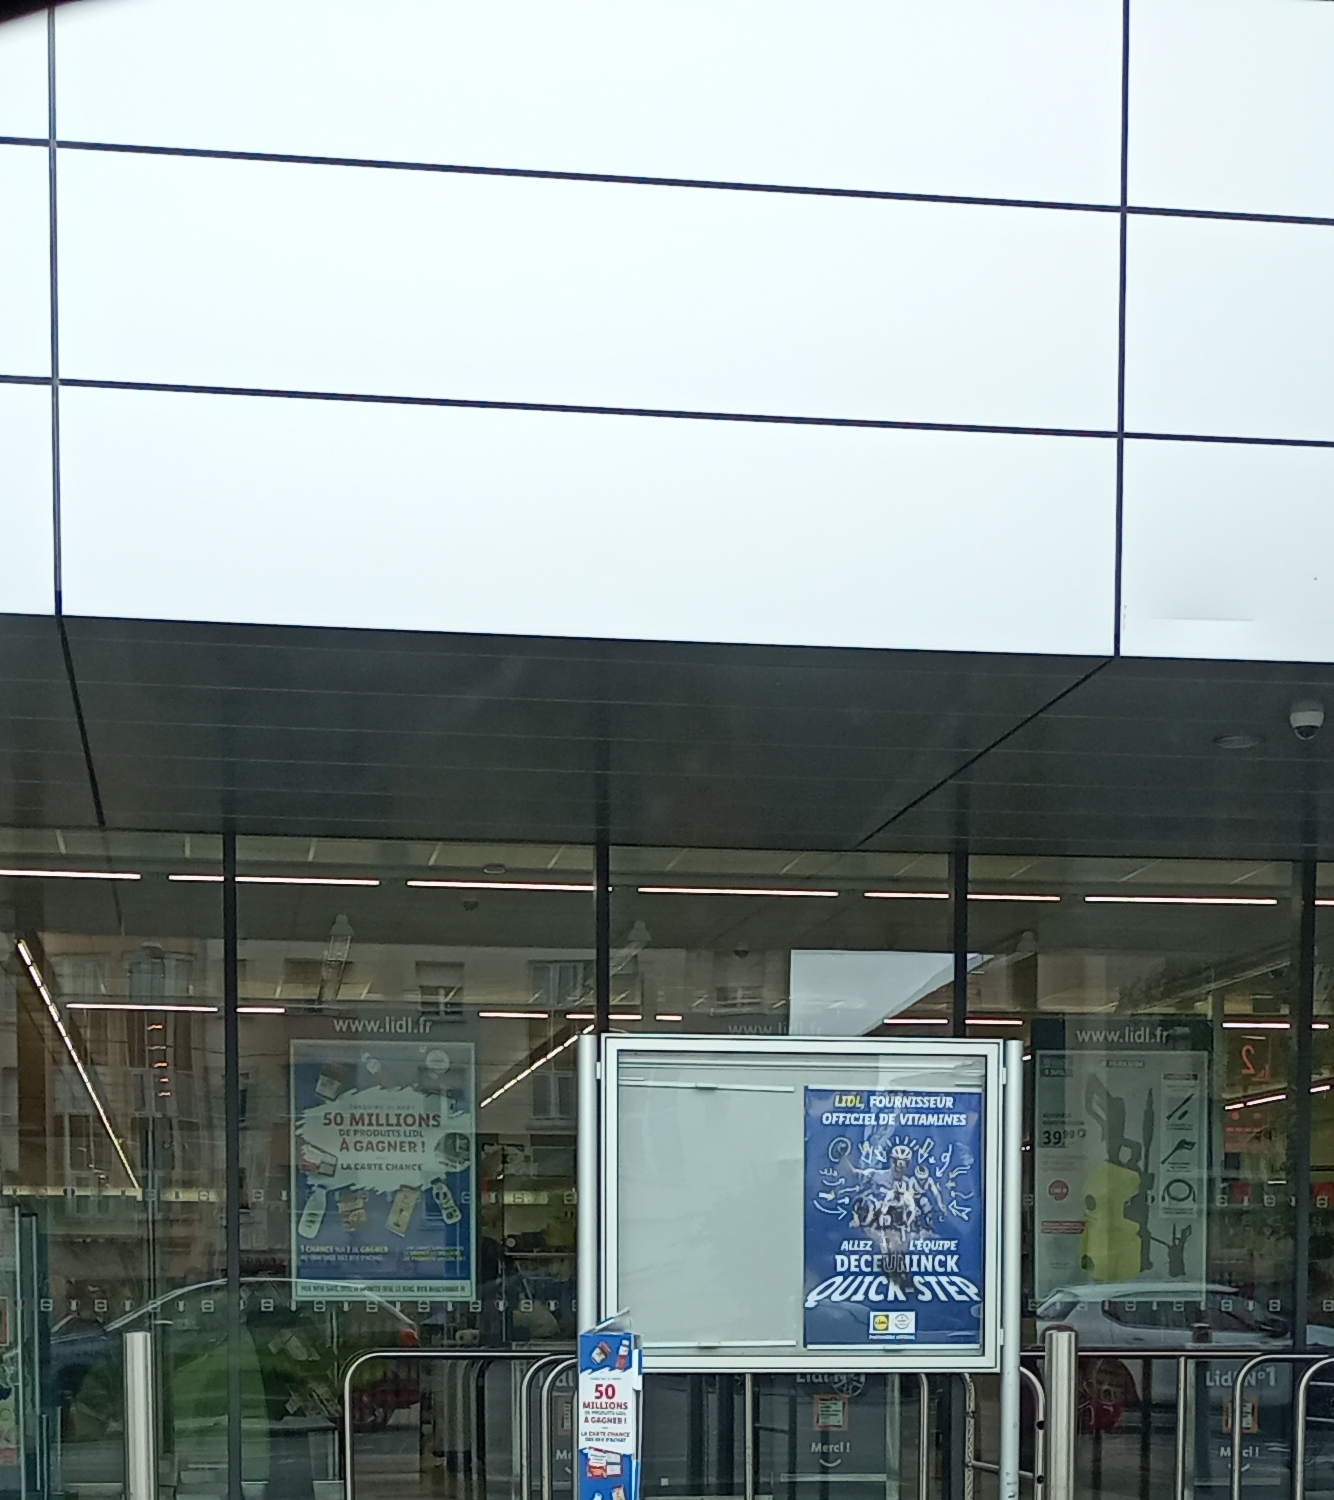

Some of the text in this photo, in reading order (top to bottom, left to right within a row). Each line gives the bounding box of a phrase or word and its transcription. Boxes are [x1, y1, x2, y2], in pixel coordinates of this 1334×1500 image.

[334, 1016, 433, 1033] www.lidl.fr
[1076, 1027, 1169, 1044] www.lidl.fr
[869, 1096, 954, 1108] FOURNISSEUR
[323, 1113, 442, 1127] 50 MILLIONS
[822, 1113, 967, 1126] OFFICIEL DE VITAMINES
[339, 1129, 351, 1137] DE
[353, 1129, 401, 1138] PRODUITS
[340, 1138, 426, 1153] À GAGNER !
[341, 1163, 422, 1171] LA CARTE CHANCE
[840, 1240, 873, 1251] ALLEZ
[835, 1254, 959, 1272] DECEUNINCK
[804, 1275, 982, 1308] QUICK-STEP
[1206, 1370, 1236, 1386] Lid
[594, 1384, 616, 1400] 50
[583, 1401, 628, 1410] MILLIONS
[811, 1441, 844, 1453] Merci
[1220, 1446, 1253, 1457] Mci
